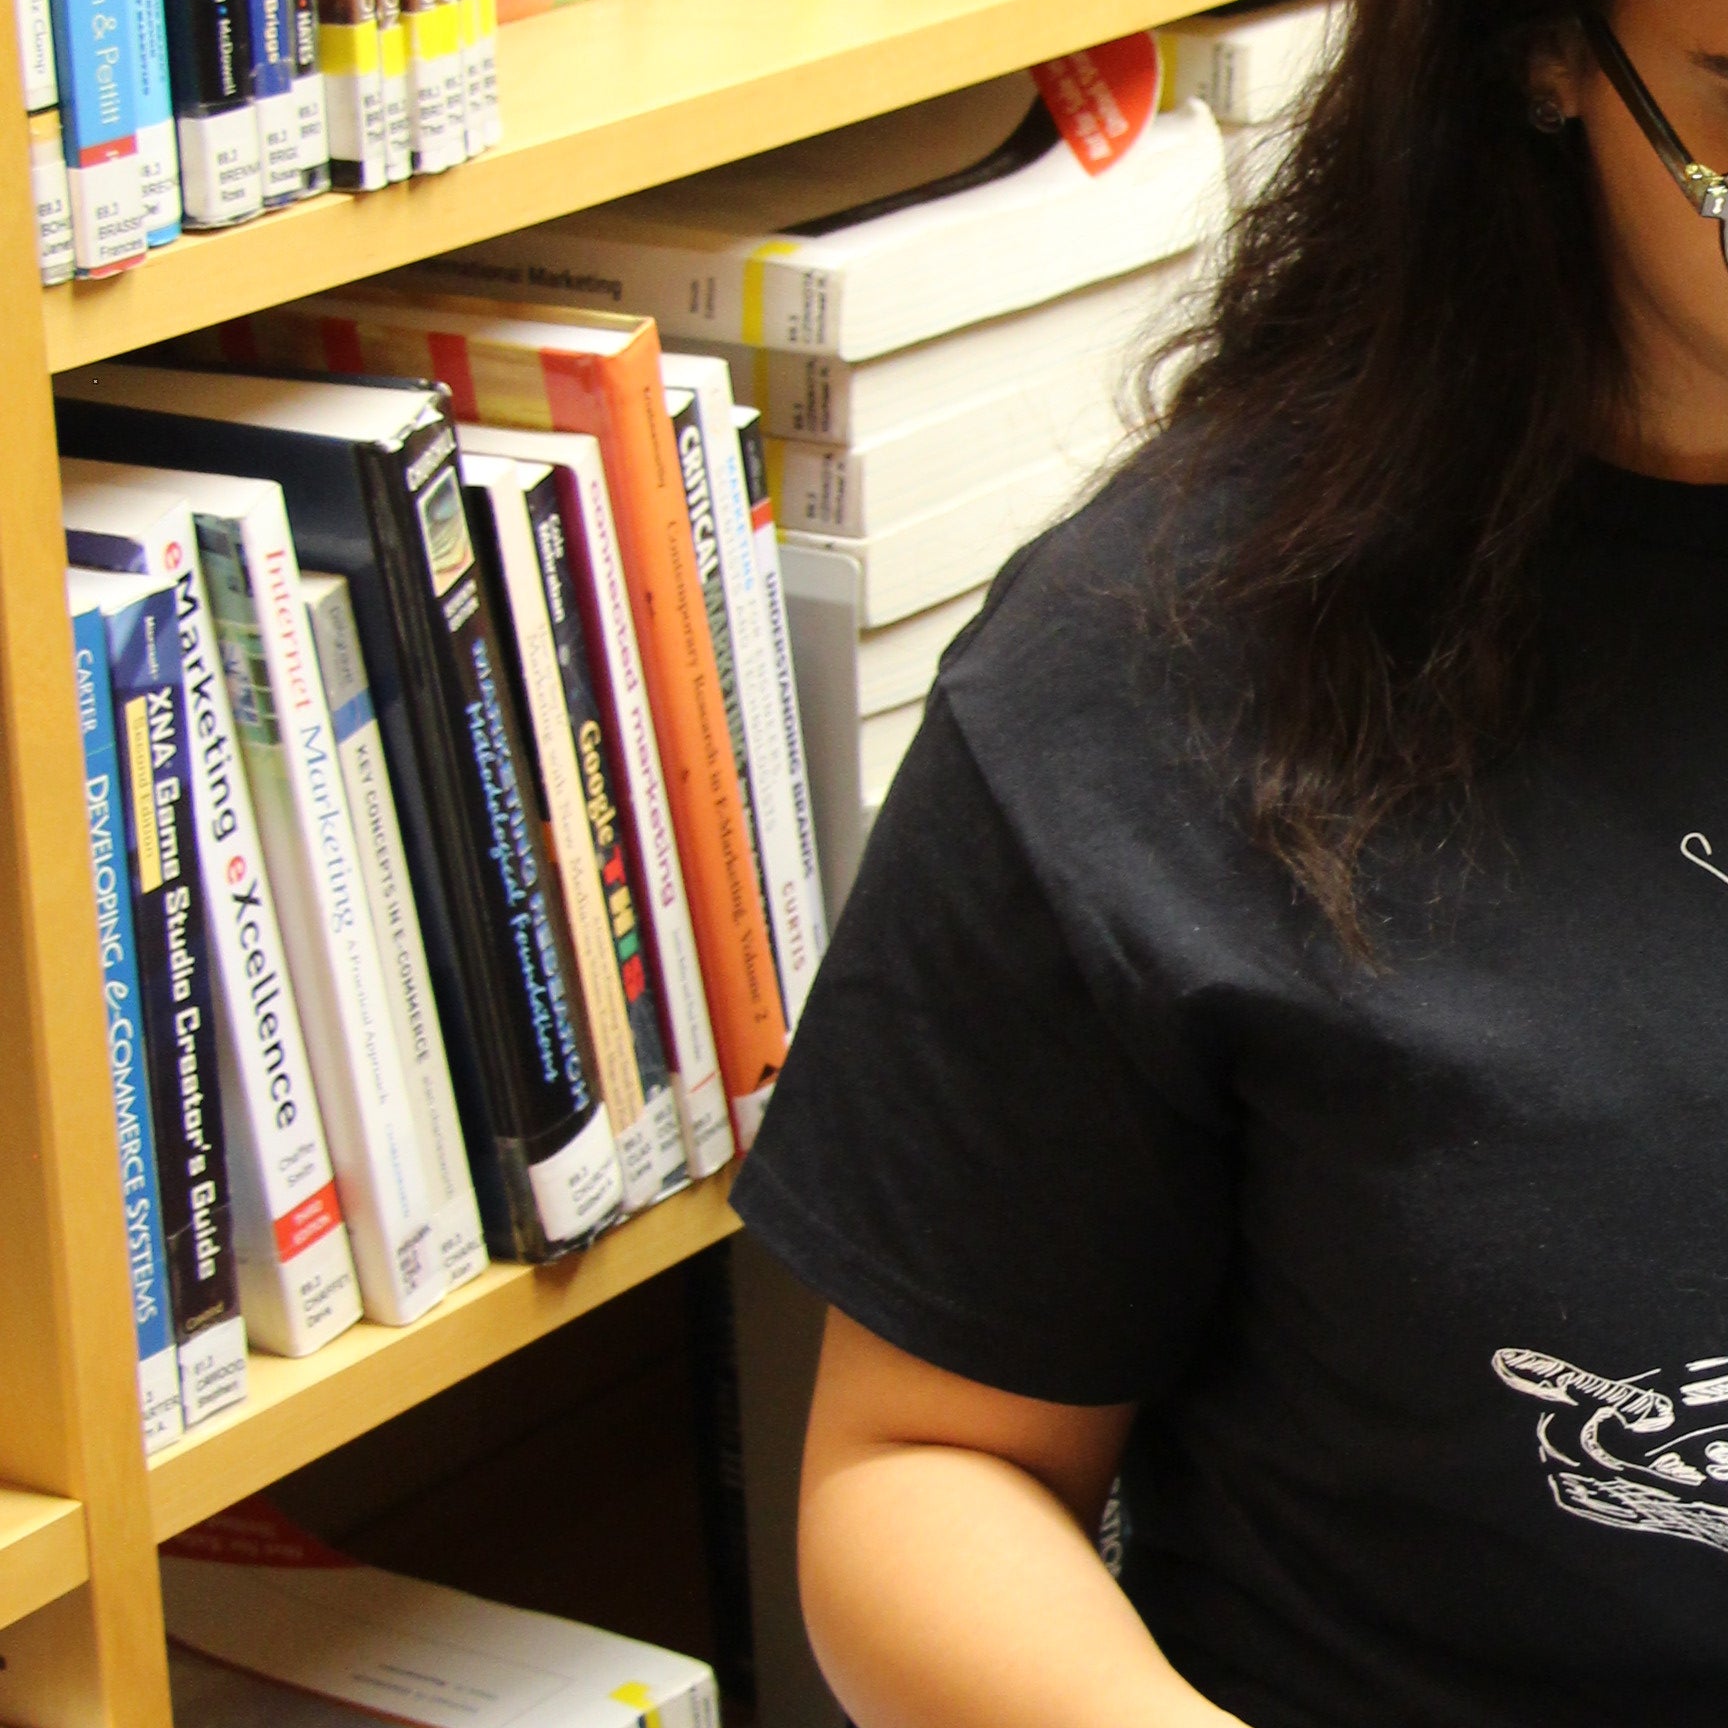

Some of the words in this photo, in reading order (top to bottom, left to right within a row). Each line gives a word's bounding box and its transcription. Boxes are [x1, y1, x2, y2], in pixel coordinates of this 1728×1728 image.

[679, 422, 720, 585] CRITICAL
[147, 686, 178, 770] XNA
[265, 548, 313, 712] Internet
[300, 723, 354, 935] Marketing
[579, 718, 618, 851] Google
[632, 706, 677, 909] marketing
[154, 775, 182, 882] Game
[163, 886, 194, 1005] Studio
[365, 788, 394, 893] CONCEPTS
[393, 927, 431, 1066] E-COMMERCE
[85, 773, 126, 968] DEVELOPING
[123, 1196, 160, 1327] SYSTEMS
[174, 1005, 213, 1178] Creator's
[190, 1184, 224, 1282] Guide
